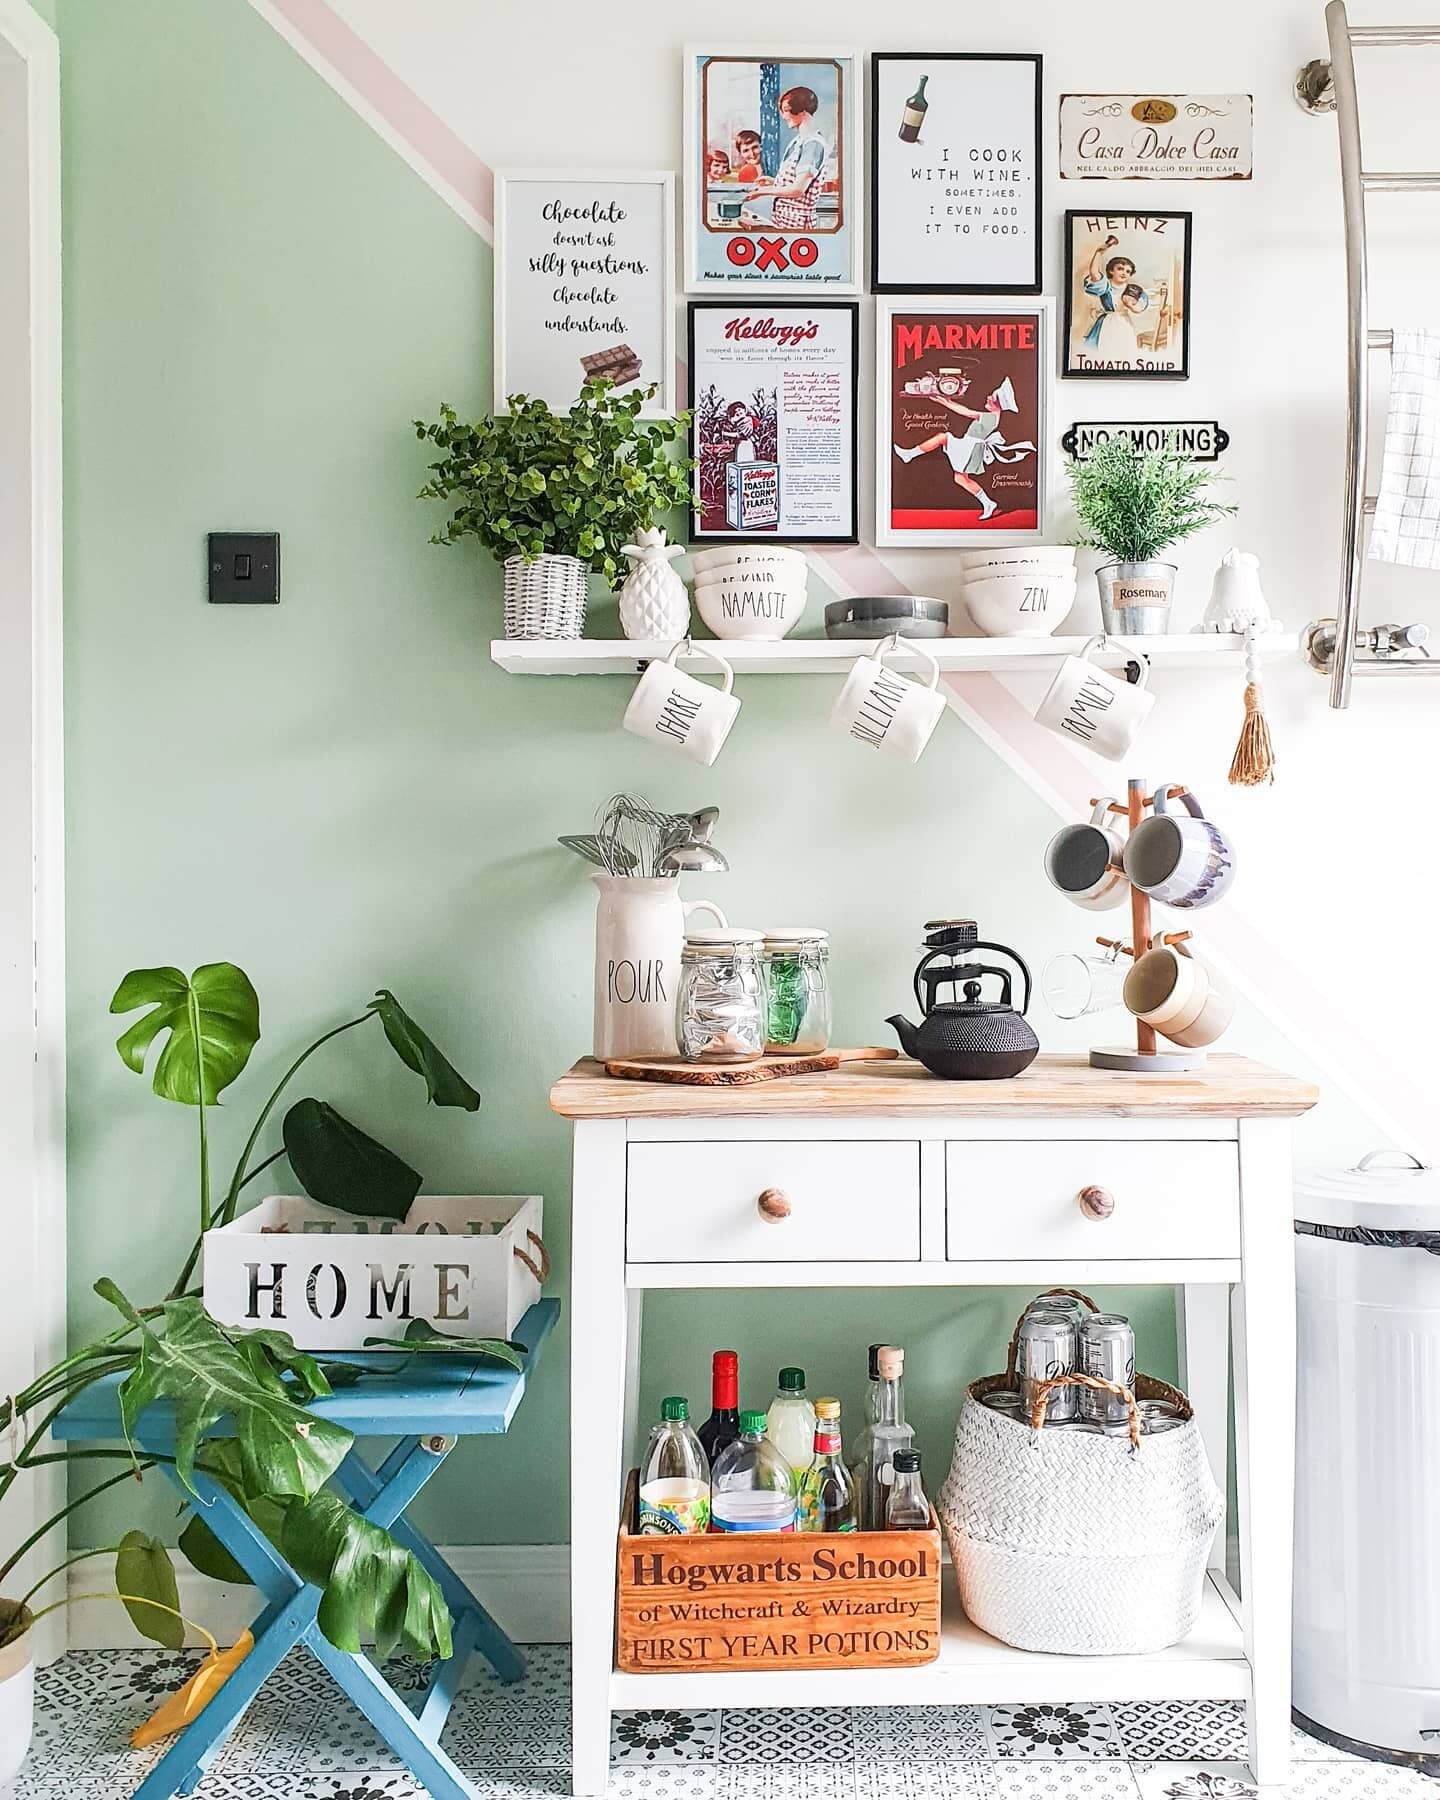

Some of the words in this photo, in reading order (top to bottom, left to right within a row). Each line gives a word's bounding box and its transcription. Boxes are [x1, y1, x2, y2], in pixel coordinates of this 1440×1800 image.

[1078, 127, 1124, 159] Casa
[1131, 127, 1187, 159] Dolce
[1193, 127, 1240, 159] Casa
[942, 149, 949, 162] I
[969, 149, 1023, 163] COOK
[911, 168, 959, 181] WITH
[973, 169, 1032, 182] WINE.
[542, 199, 627, 223] Chocolate
[946, 206, 982, 215] EVEN
[992, 207, 1018, 216] ADD
[925, 224, 942, 234] IT
[954, 224, 971, 234] TO
[983, 224, 1027, 235] FOOD.
[1086, 216, 1169, 235] HEINZ
[553, 231, 594, 246] doesn't
[596, 231, 616, 247] ask
[528, 252, 567, 277] silly
[571, 253, 649, 277] questions.
[726, 236, 819, 272] OXO
[552, 286, 619, 305] Chocolate
[545, 315, 629, 333] understands.
[724, 317, 819, 345] Kellogg's
[896, 324, 1035, 369] MARMITE
[1081, 430, 1110, 452] NO
[1118, 429, 1211, 452] MOING
[743, 480, 776, 491] TOASTED
[750, 489, 771, 499] CORN
[746, 497, 774, 509] FLAKES
[721, 591, 787, 619] NAMASTE
[1019, 587, 1049, 612] ZEN
[1119, 588, 1168, 602] Rosemary
[655, 688, 703, 744] SHARE
[1060, 675, 1116, 741] FAMILY
[608, 960, 667, 1003] POUR
[243, 1263, 470, 1320] HOME
[631, 1552, 802, 1591] Hogwarts
[812, 1548, 927, 1581] School
[638, 1603, 661, 1622] of
[668, 1600, 784, 1623] Witchcraft
[792, 1600, 811, 1617] &
[821, 1597, 921, 1618] Wizardry
[633, 1636, 712, 1661] FIRST
[719, 1633, 798, 1657] YEAR
[808, 1629, 930, 1656] POTIONS
